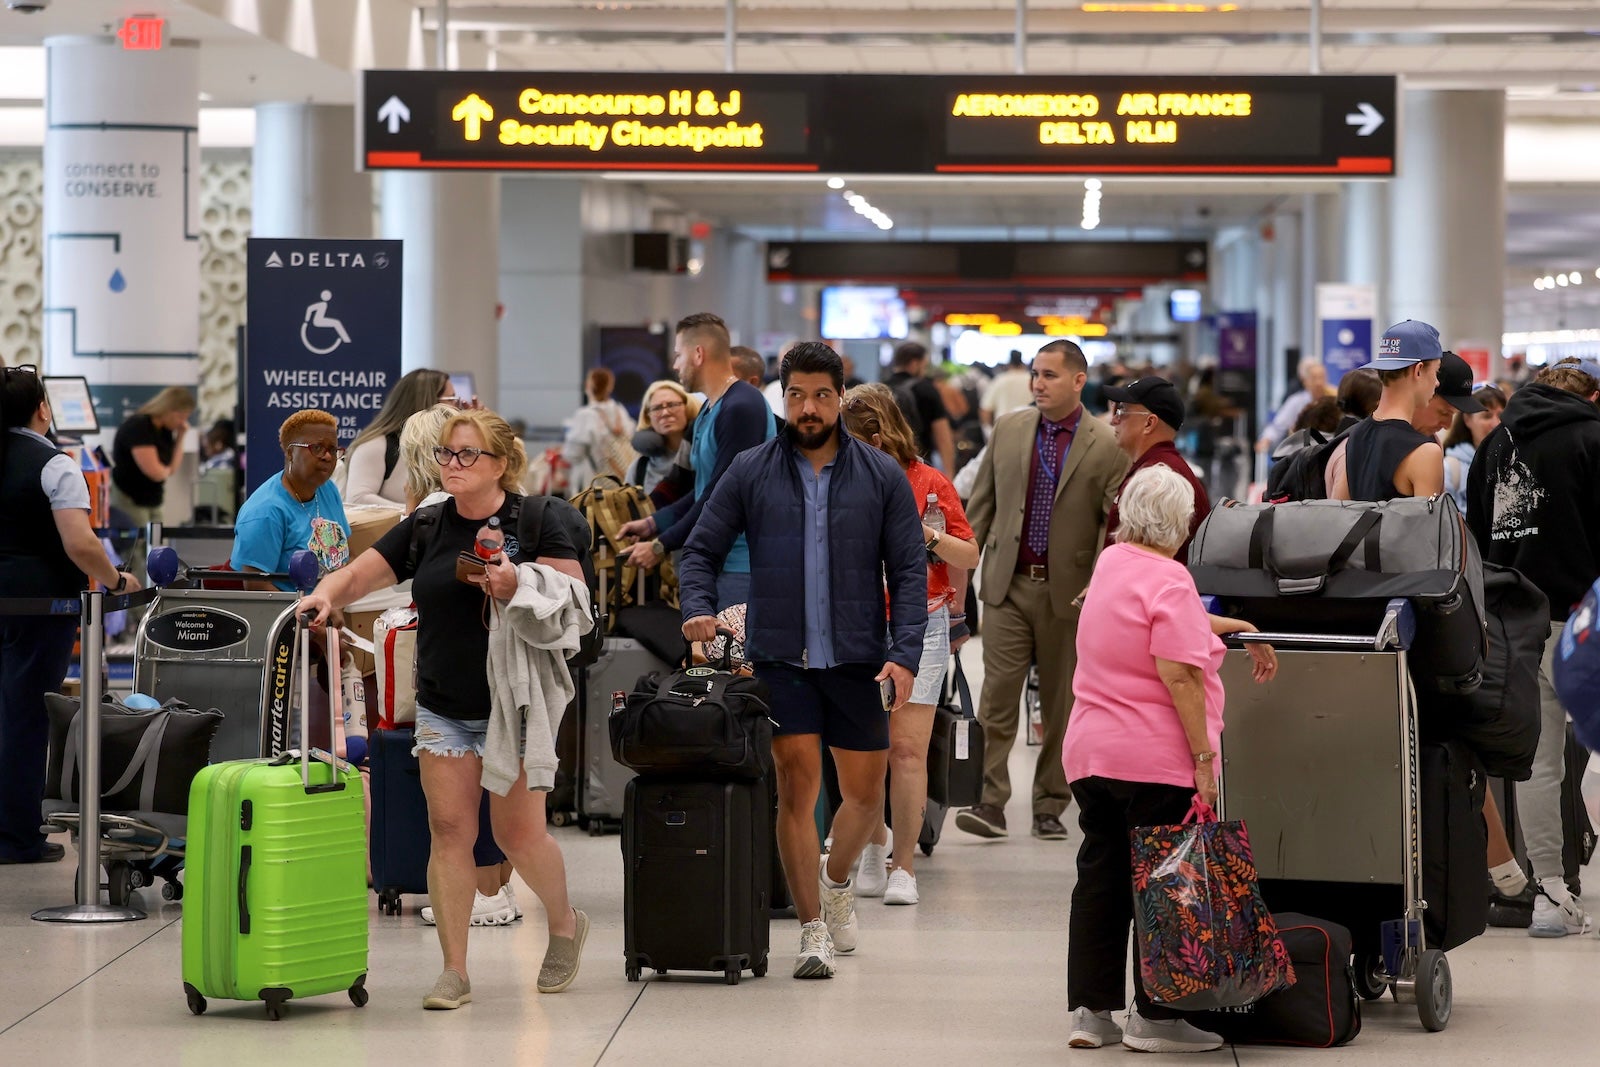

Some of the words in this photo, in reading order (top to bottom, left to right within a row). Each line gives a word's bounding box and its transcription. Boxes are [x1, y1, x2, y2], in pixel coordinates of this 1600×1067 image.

[124, 18, 164, 50] EXIT
[518, 88, 666, 115] Concourse
[669, 90, 692, 116] H
[695, 90, 720, 116] &
[721, 90, 741, 116] J
[952, 94, 1099, 116] AEROMEXICO
[1117, 93, 1158, 115] AIR
[1158, 93, 1251, 116] FRANCE
[499, 119, 609, 151] Security
[611, 120, 763, 152] Checkpoint
[1039, 122, 1115, 144] DELTA
[1126, 121, 1177, 143] KLM
[64, 162, 134, 178] connect
[141, 162, 160, 178] to
[290, 251, 366, 268] DELTA
[264, 370, 387, 388] WHEELCHAIR
[267, 391, 383, 409] ASSISTANCE
[342, 416, 357, 427] DE
[1491, 530, 1511, 540] WAY
[175, 621, 205, 629] Welcome
[206, 621, 214, 629] to
[177, 630, 210, 641] Miami
[271, 643, 289, 758] martecarte
